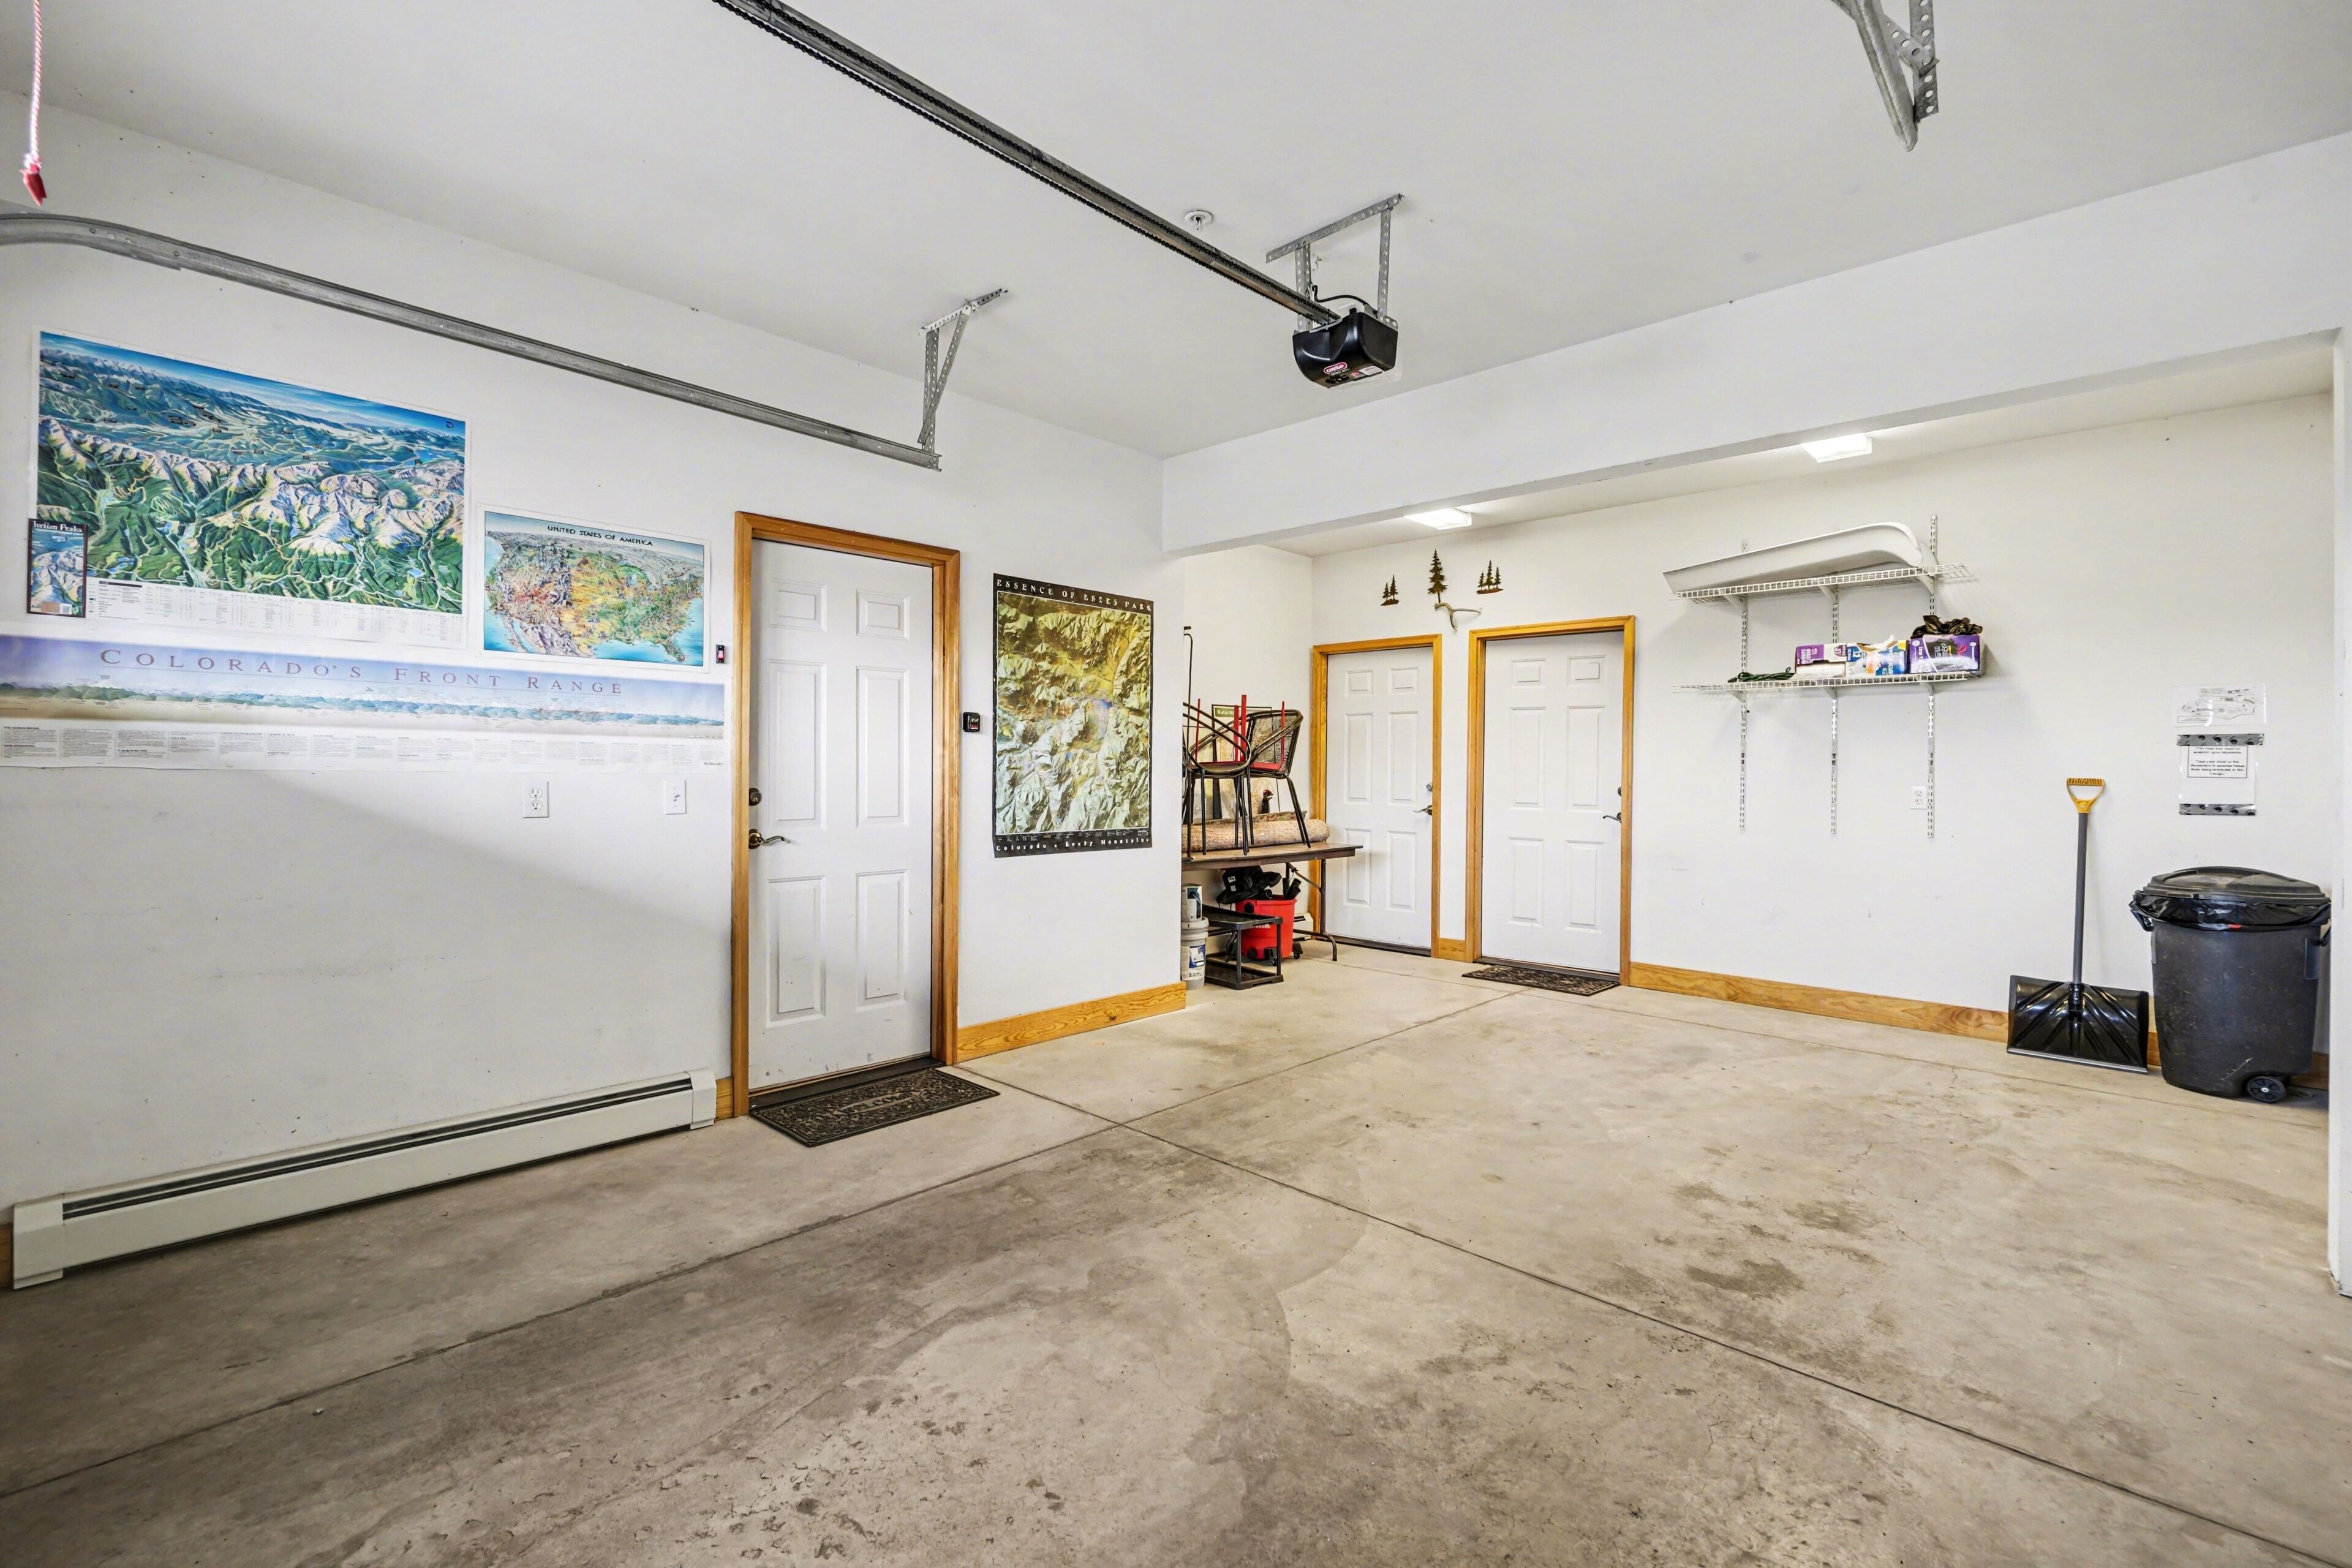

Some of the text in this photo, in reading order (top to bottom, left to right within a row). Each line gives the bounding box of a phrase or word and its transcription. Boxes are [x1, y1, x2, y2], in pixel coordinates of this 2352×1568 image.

[548, 526, 576, 534] UNITED
[619, 537, 653, 546] AMERICA
[997, 579, 1151, 611] ESSENCE OF ESTES PARK
[100, 649, 621, 693] COLORADO'S FRONT RANGE
